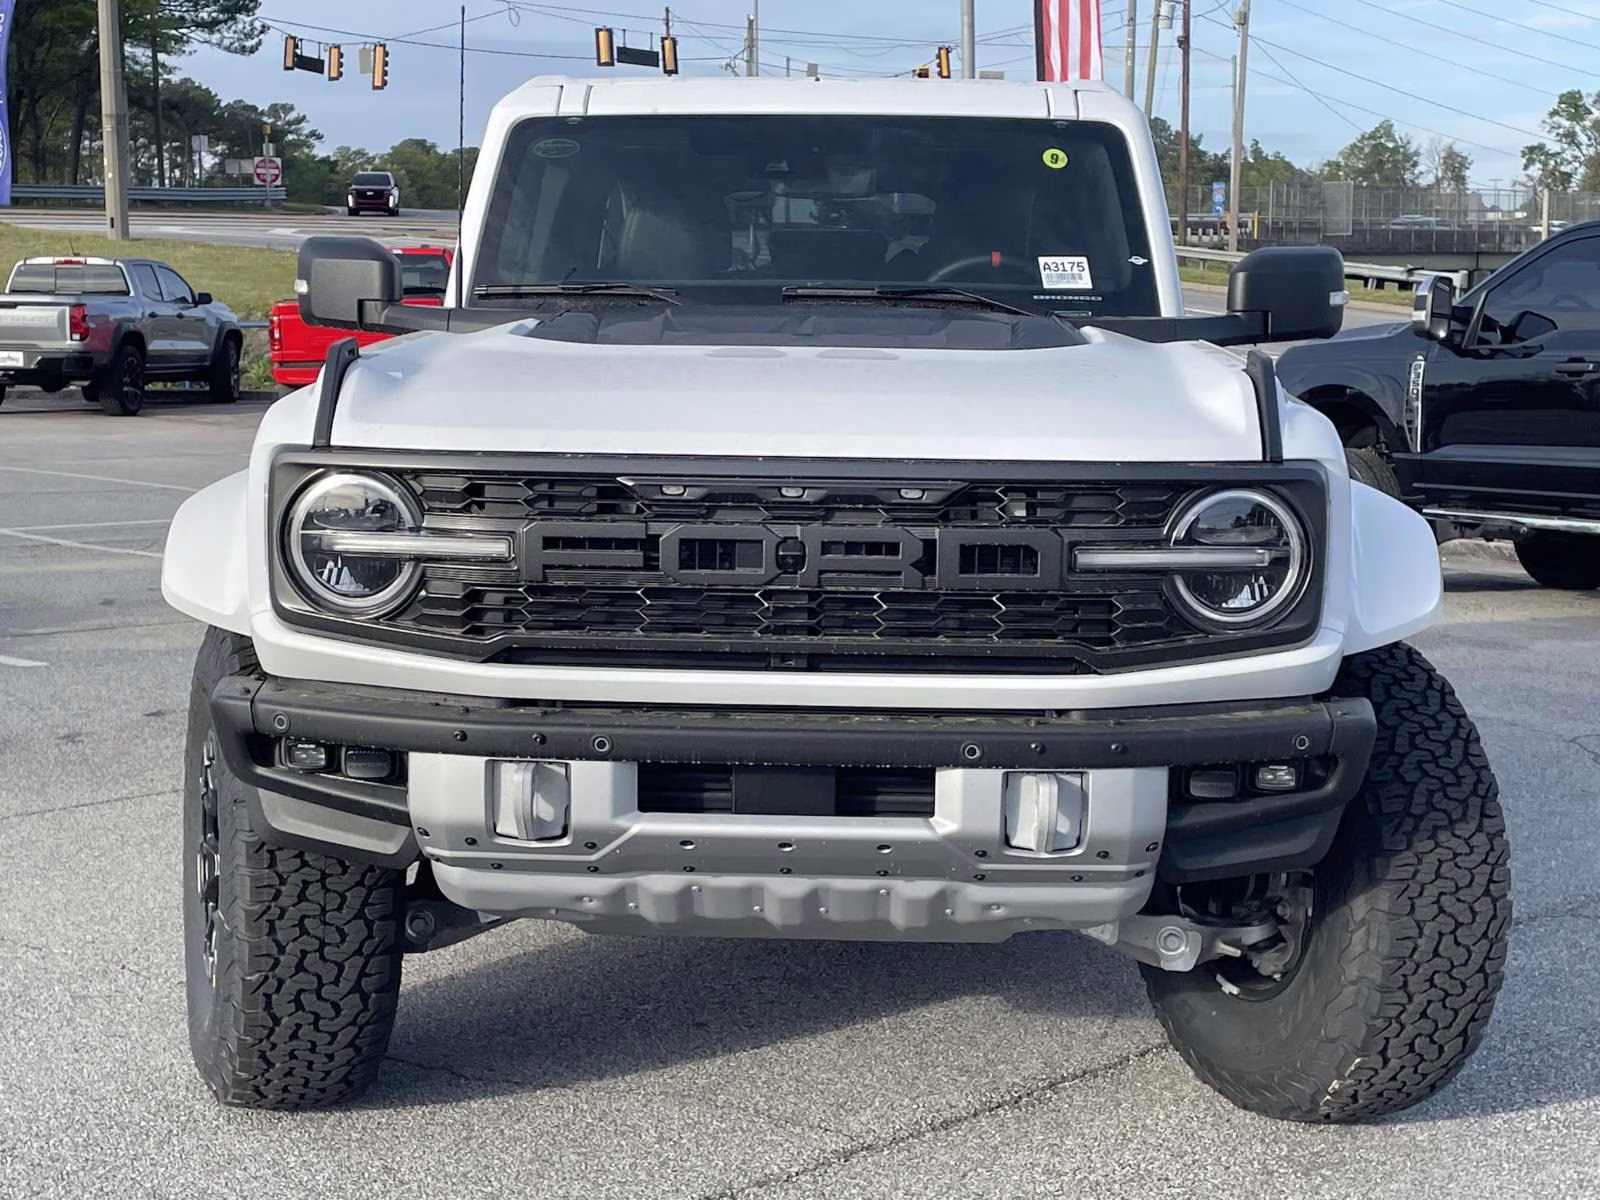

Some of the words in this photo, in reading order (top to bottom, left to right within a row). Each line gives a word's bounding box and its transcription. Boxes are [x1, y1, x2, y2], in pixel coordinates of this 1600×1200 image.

[1050, 153, 1059, 164] 9
[1043, 261, 1086, 273] A3175
[522, 521, 1064, 591] FORD
